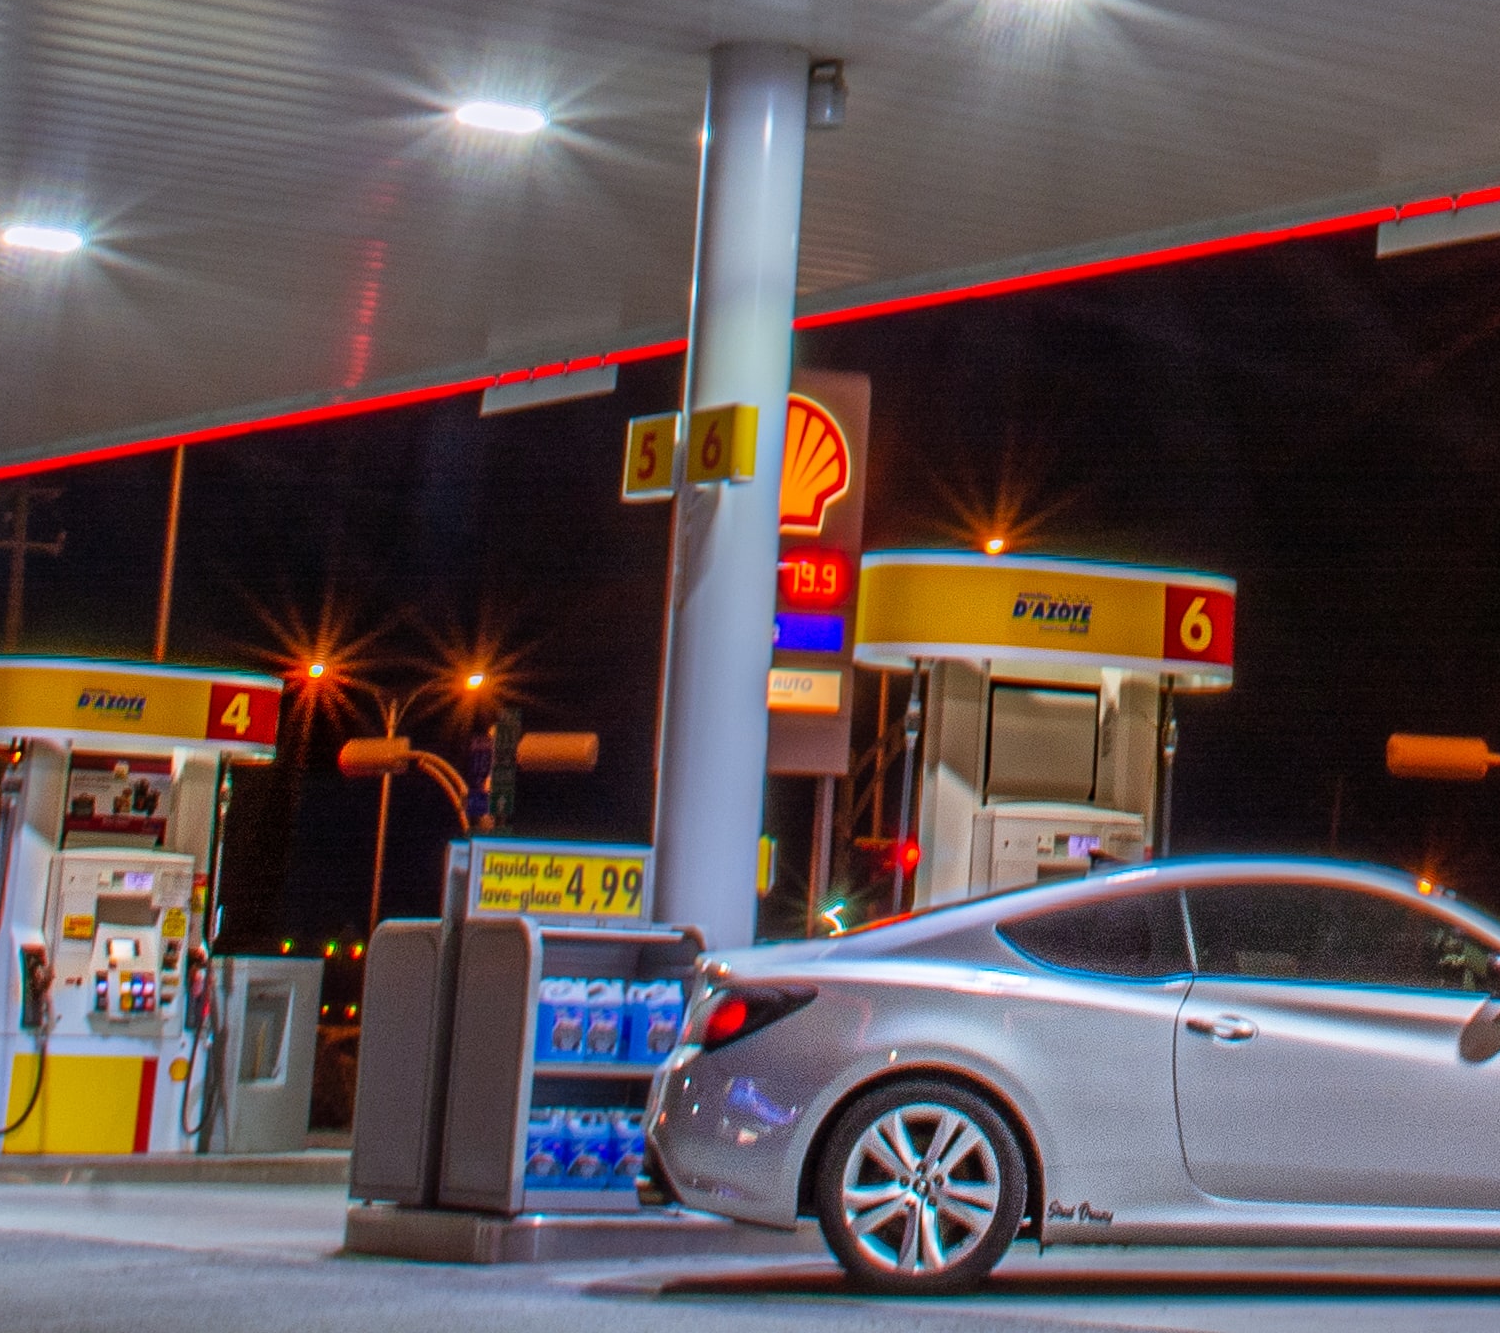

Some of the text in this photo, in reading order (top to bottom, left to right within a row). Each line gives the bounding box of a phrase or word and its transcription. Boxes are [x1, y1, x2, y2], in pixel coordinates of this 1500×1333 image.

[637, 432, 657, 481] 5
[701, 421, 722, 471] 6
[1012, 598, 1092, 624] D'AZOTE
[1180, 596, 1212, 652] 6
[772, 675, 813, 692] AUTO
[220, 692, 250, 735] 4
[481, 854, 564, 881] Liquide de
[566, 862, 642, 911] 4,99
